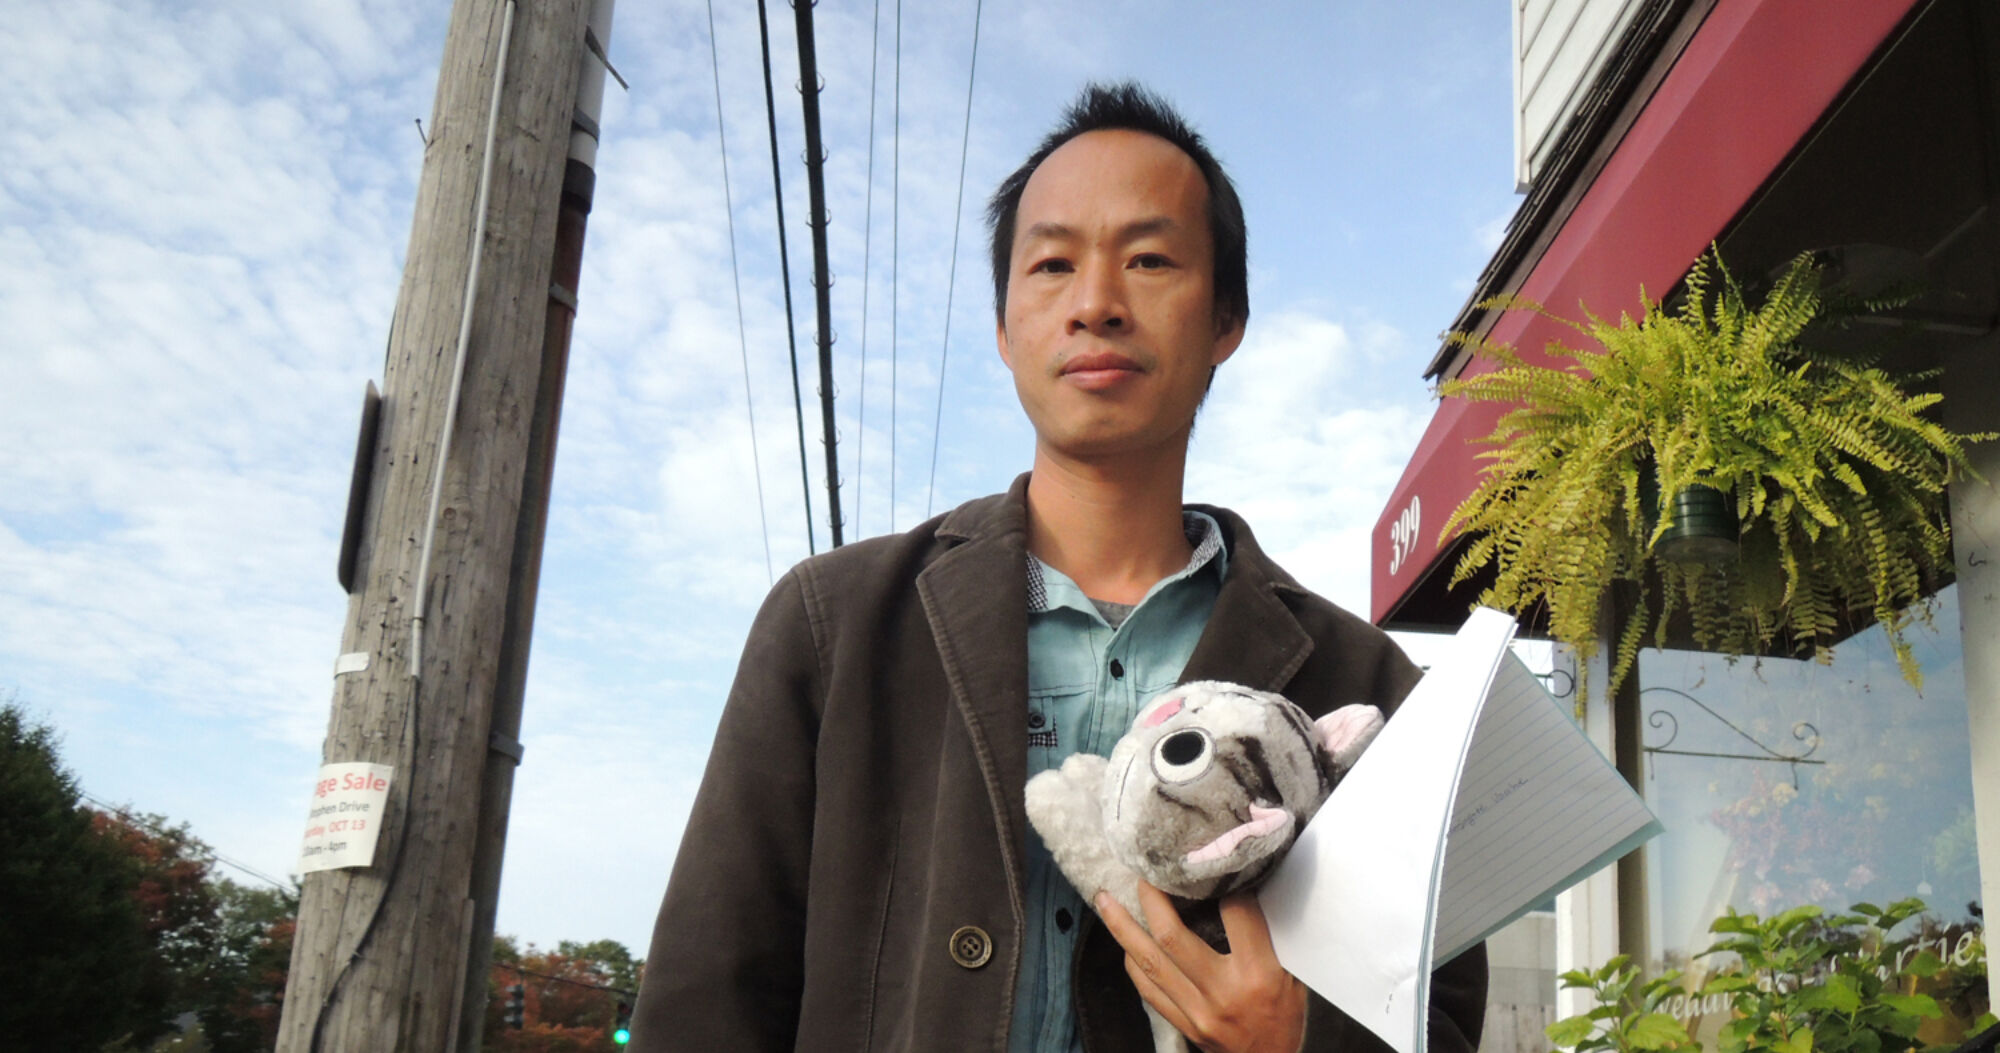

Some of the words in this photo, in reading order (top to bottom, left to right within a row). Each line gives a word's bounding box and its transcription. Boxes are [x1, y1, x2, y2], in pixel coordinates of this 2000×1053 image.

[1390, 495, 1420, 576] 399
[342, 771, 387, 792] Sale
[339, 801, 370, 812] Drive
[328, 819, 349, 833] OCT
[351, 819, 367, 831] 13
